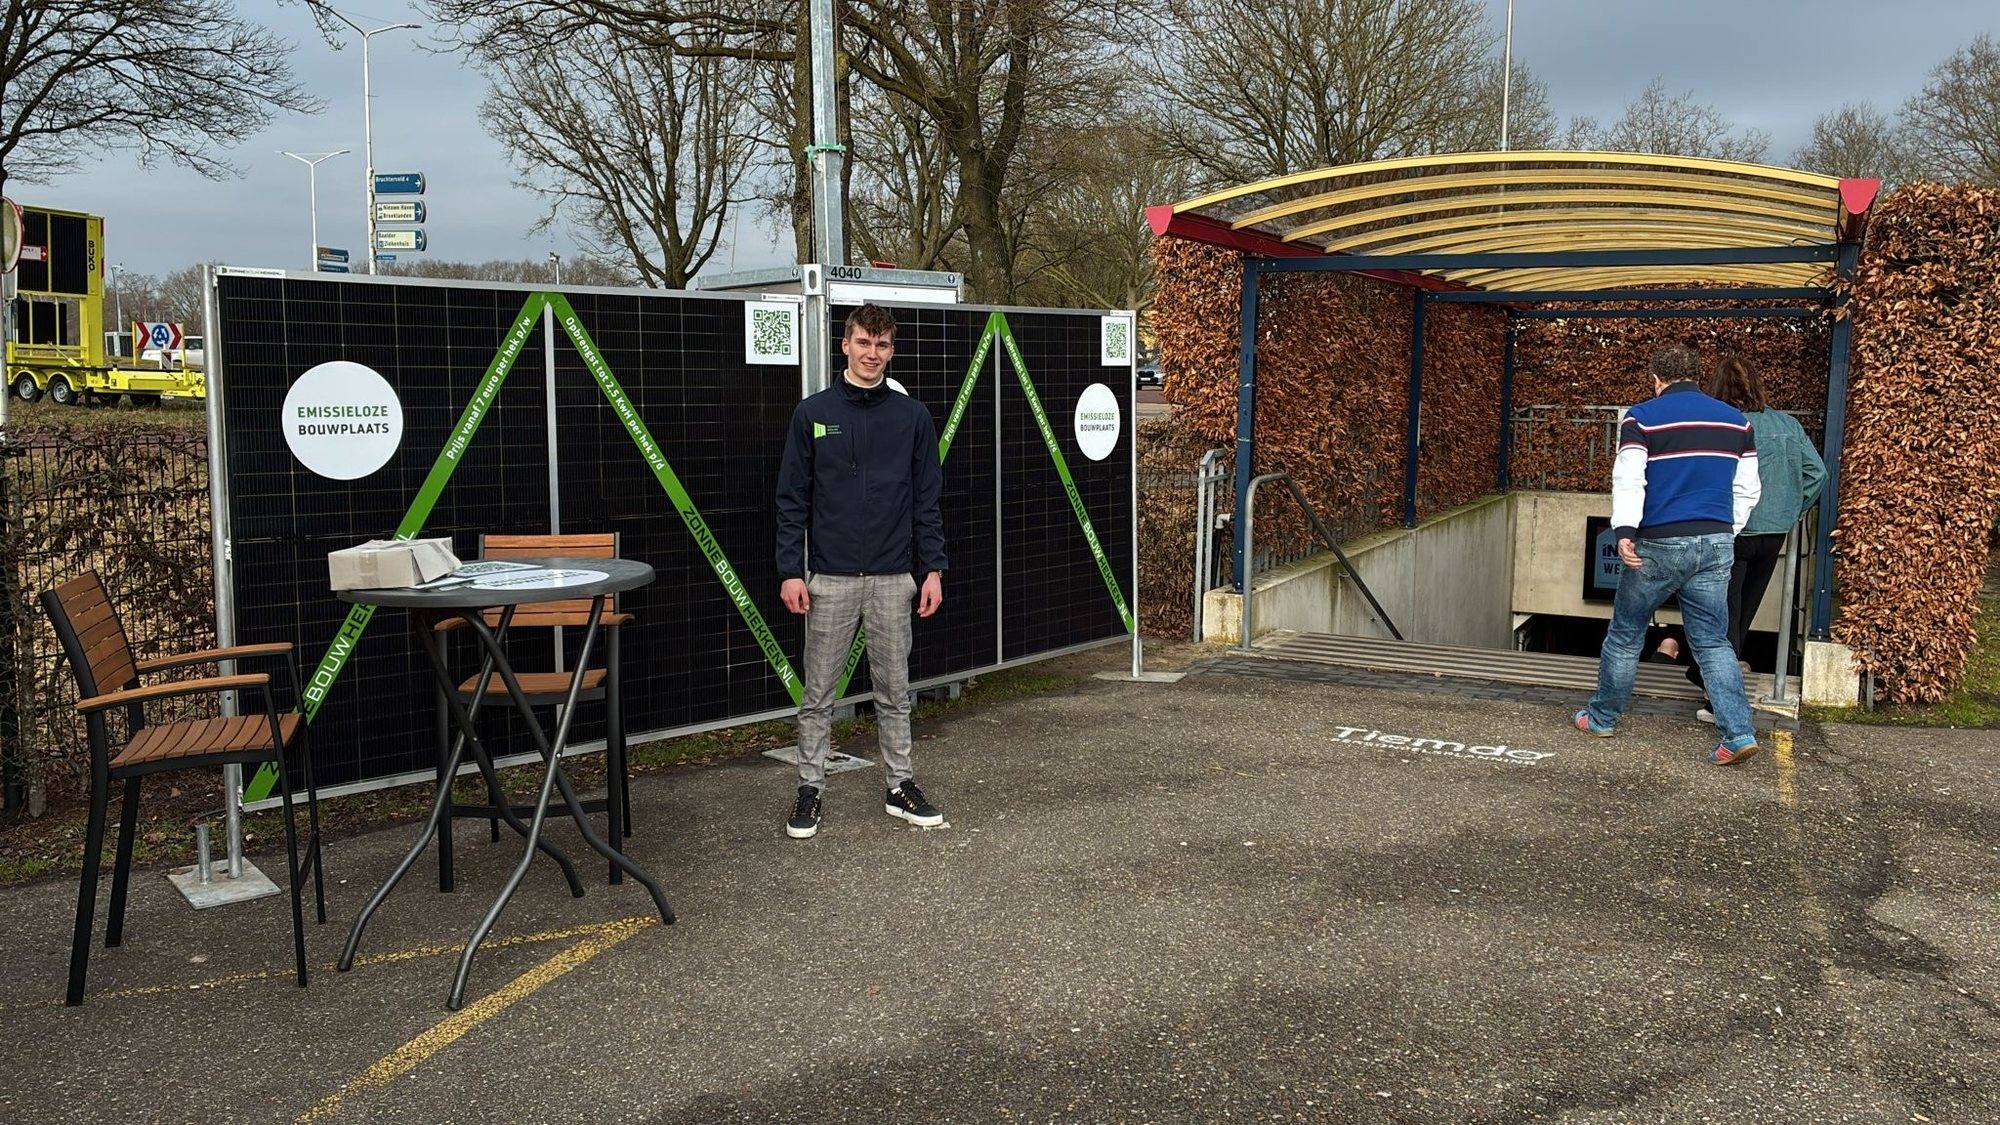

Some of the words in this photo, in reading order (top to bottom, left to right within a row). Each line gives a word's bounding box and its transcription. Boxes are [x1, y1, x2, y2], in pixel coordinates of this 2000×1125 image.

[831, 267, 861, 279] 4040
[446, 434, 465, 460] Prijs
[462, 405, 481, 435] vanaf
[477, 397, 486, 406] 7
[482, 375, 498, 399] euro
[495, 358, 508, 376] per
[503, 339, 519, 358] hek
[516, 316, 531, 339] p/w
[565, 316, 599, 367] Opbrengst
[596, 365, 609, 382] tot
[605, 382, 619, 398] 2,5
[615, 398, 632, 420] KwH
[628, 419, 642, 436] per
[640, 434, 653, 454] hek
[649, 452, 665, 470] p/d
[944, 426, 955, 442] Prijs
[954, 402, 963, 424] vanaf
[964, 378, 974, 396] euro
[977, 350, 985, 364] hek
[297, 406, 388, 418] EMISSIELOZE
[1080, 412, 1115, 420] EMISSIELOZE
[298, 423, 390, 435] BOUWPLAATS
[1080, 423, 1115, 431] BOUWPLAATS
[1066, 480, 1128, 622] ZONNEBOUWHEKKEN.NL
[1604, 562, 1620, 575] WE
[683, 506, 794, 689] ZONNEBOUWHEKKEN.NL
